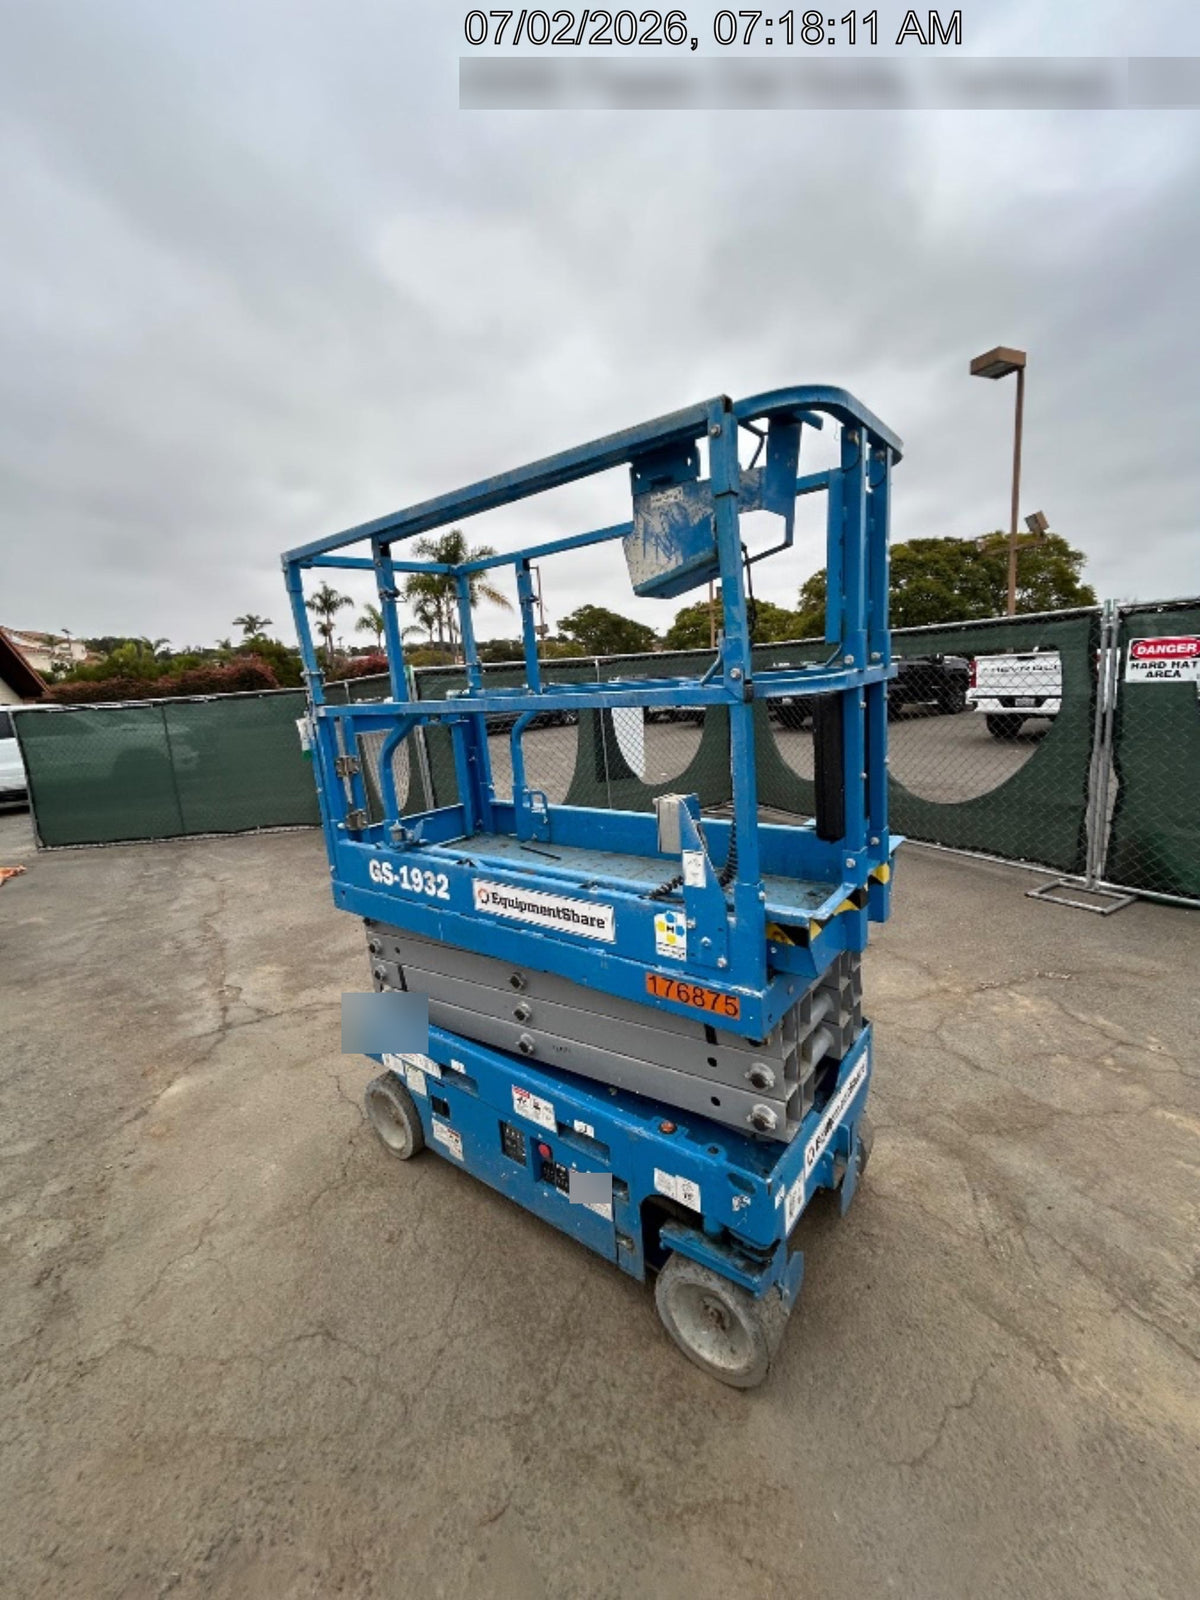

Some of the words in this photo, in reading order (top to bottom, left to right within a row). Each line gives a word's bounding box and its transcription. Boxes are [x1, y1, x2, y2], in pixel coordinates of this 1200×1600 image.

[1136, 643, 1198, 655] DANGER
[1131, 661, 1167, 670] HARD
[1171, 661, 1198, 669] HAT
[1145, 670, 1182, 678] AREA
[368, 858, 450, 901] GS-1932
[491, 892, 606, 929] EquipmentShare
[647, 974, 739, 1018] 176875
